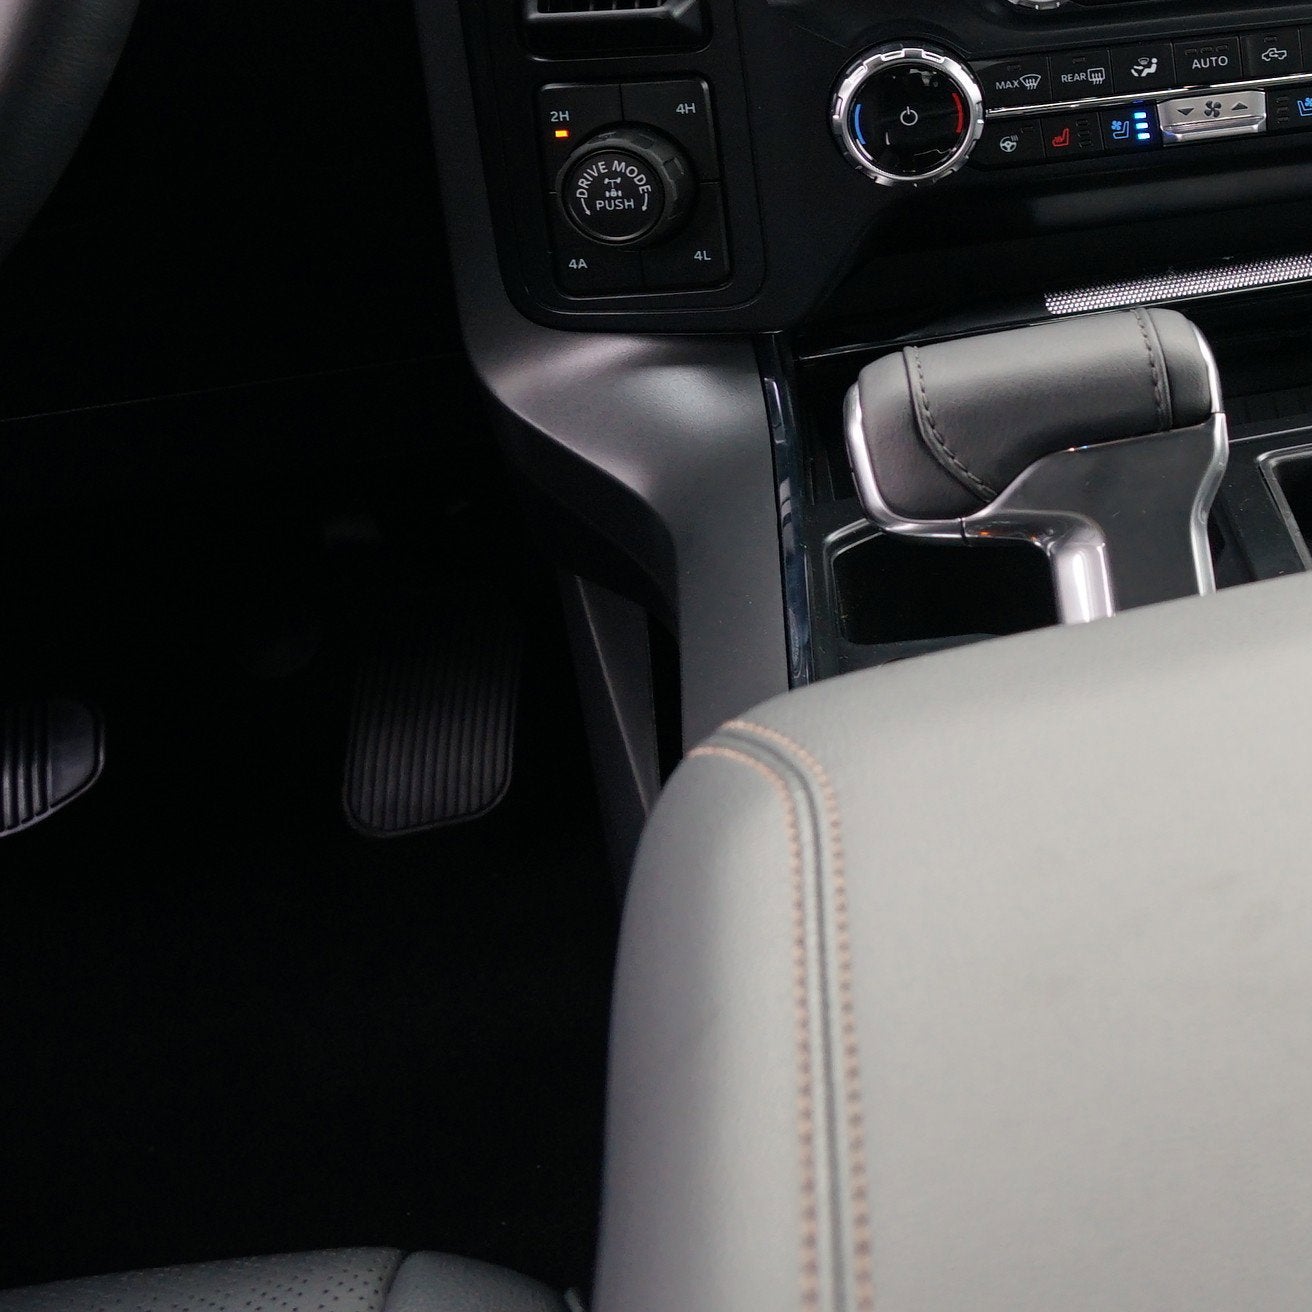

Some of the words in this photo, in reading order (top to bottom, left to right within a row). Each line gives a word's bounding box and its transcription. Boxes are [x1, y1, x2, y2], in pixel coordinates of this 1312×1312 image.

[1191, 54, 1229, 70] AUTO
[995, 77, 1020, 91] MAX
[1060, 71, 1087, 84] REAR
[675, 102, 697, 116] 4H
[550, 110, 570, 123] 2H
[576, 161, 609, 199] DRIVE
[611, 160, 652, 194] MODE
[595, 197, 635, 212] PUSH
[693, 249, 712, 261] 4L
[568, 257, 589, 270] 4A
